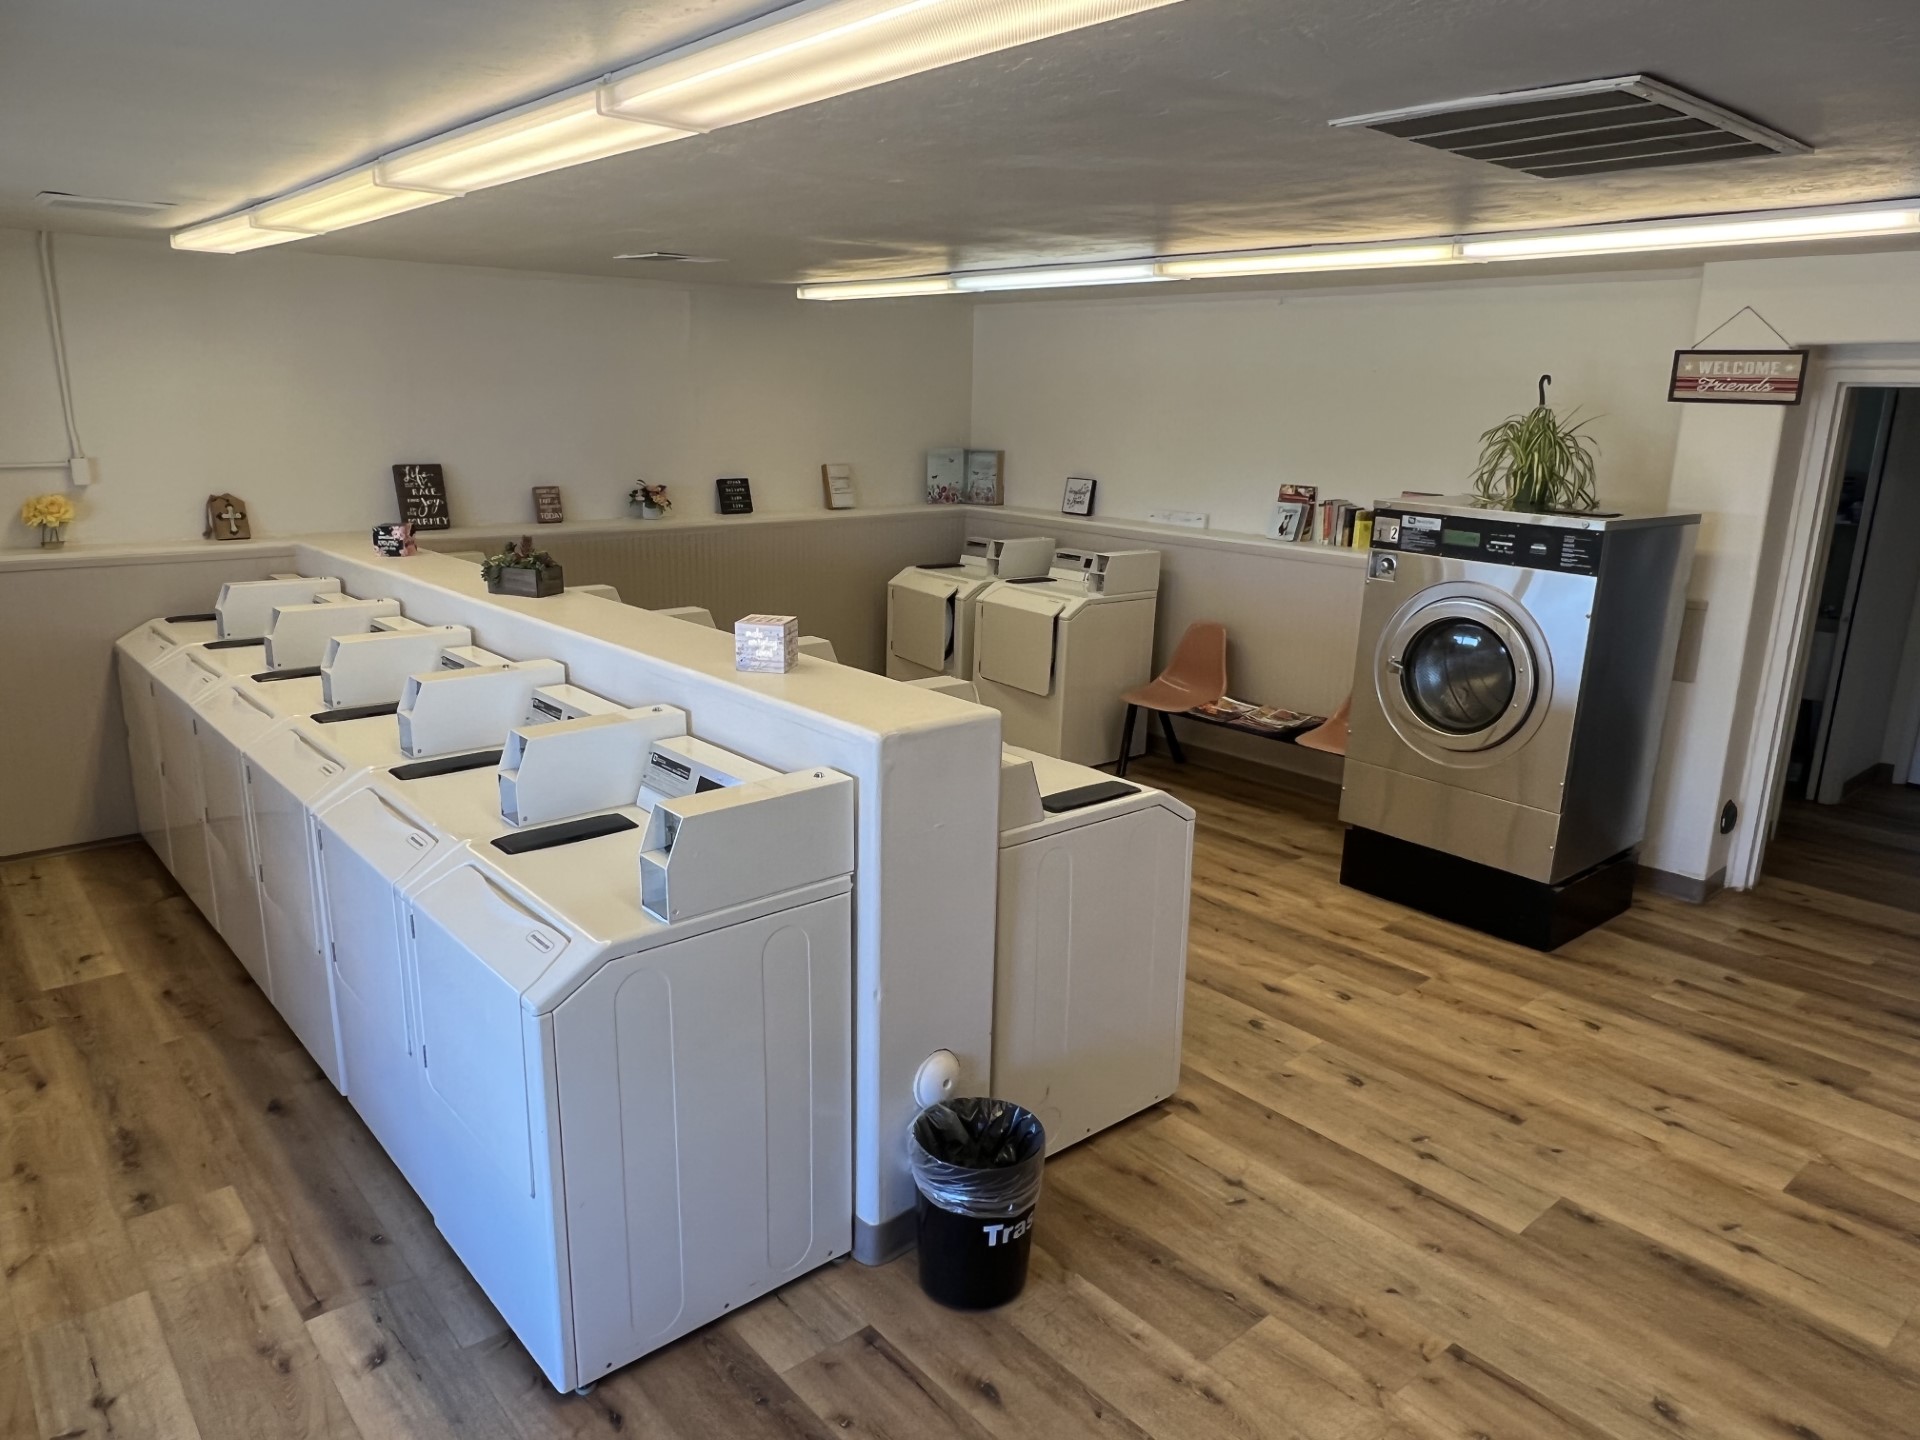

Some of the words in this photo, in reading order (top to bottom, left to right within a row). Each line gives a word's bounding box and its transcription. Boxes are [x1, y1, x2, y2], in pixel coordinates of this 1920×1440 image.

[1699, 360, 1781, 376] WELCOME
[1696, 376, 1775, 393] Friends
[411, 487, 441, 496] RACE
[1390, 526, 1398, 540] 2
